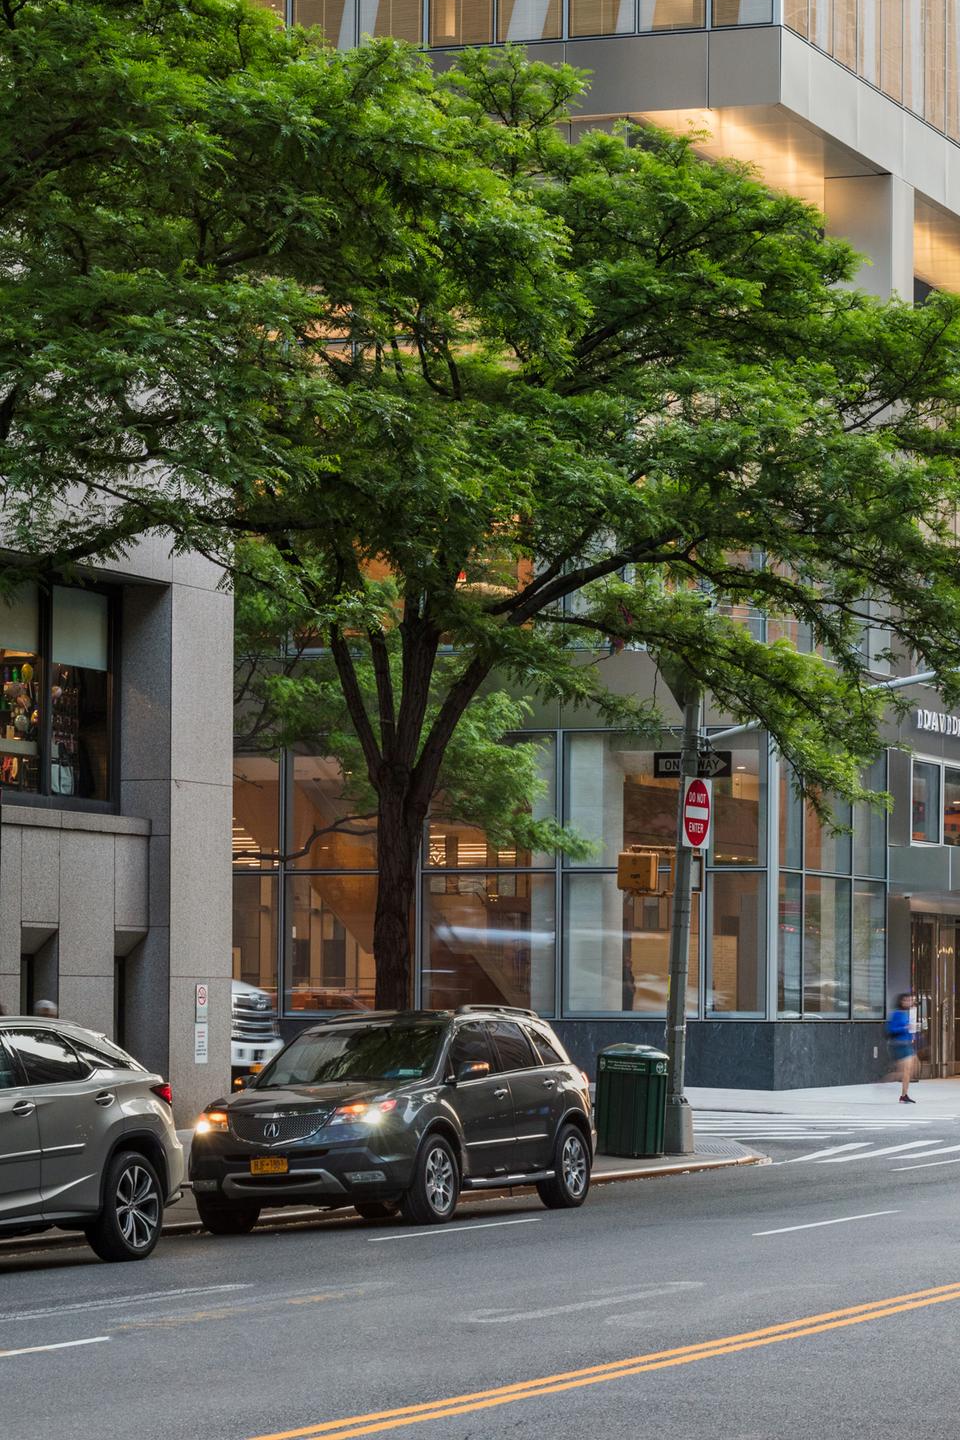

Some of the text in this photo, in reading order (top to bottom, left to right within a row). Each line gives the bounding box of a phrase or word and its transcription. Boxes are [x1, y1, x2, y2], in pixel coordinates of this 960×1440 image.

[689, 792, 706, 804] DO NOT
[689, 822, 704, 833] ENTER
